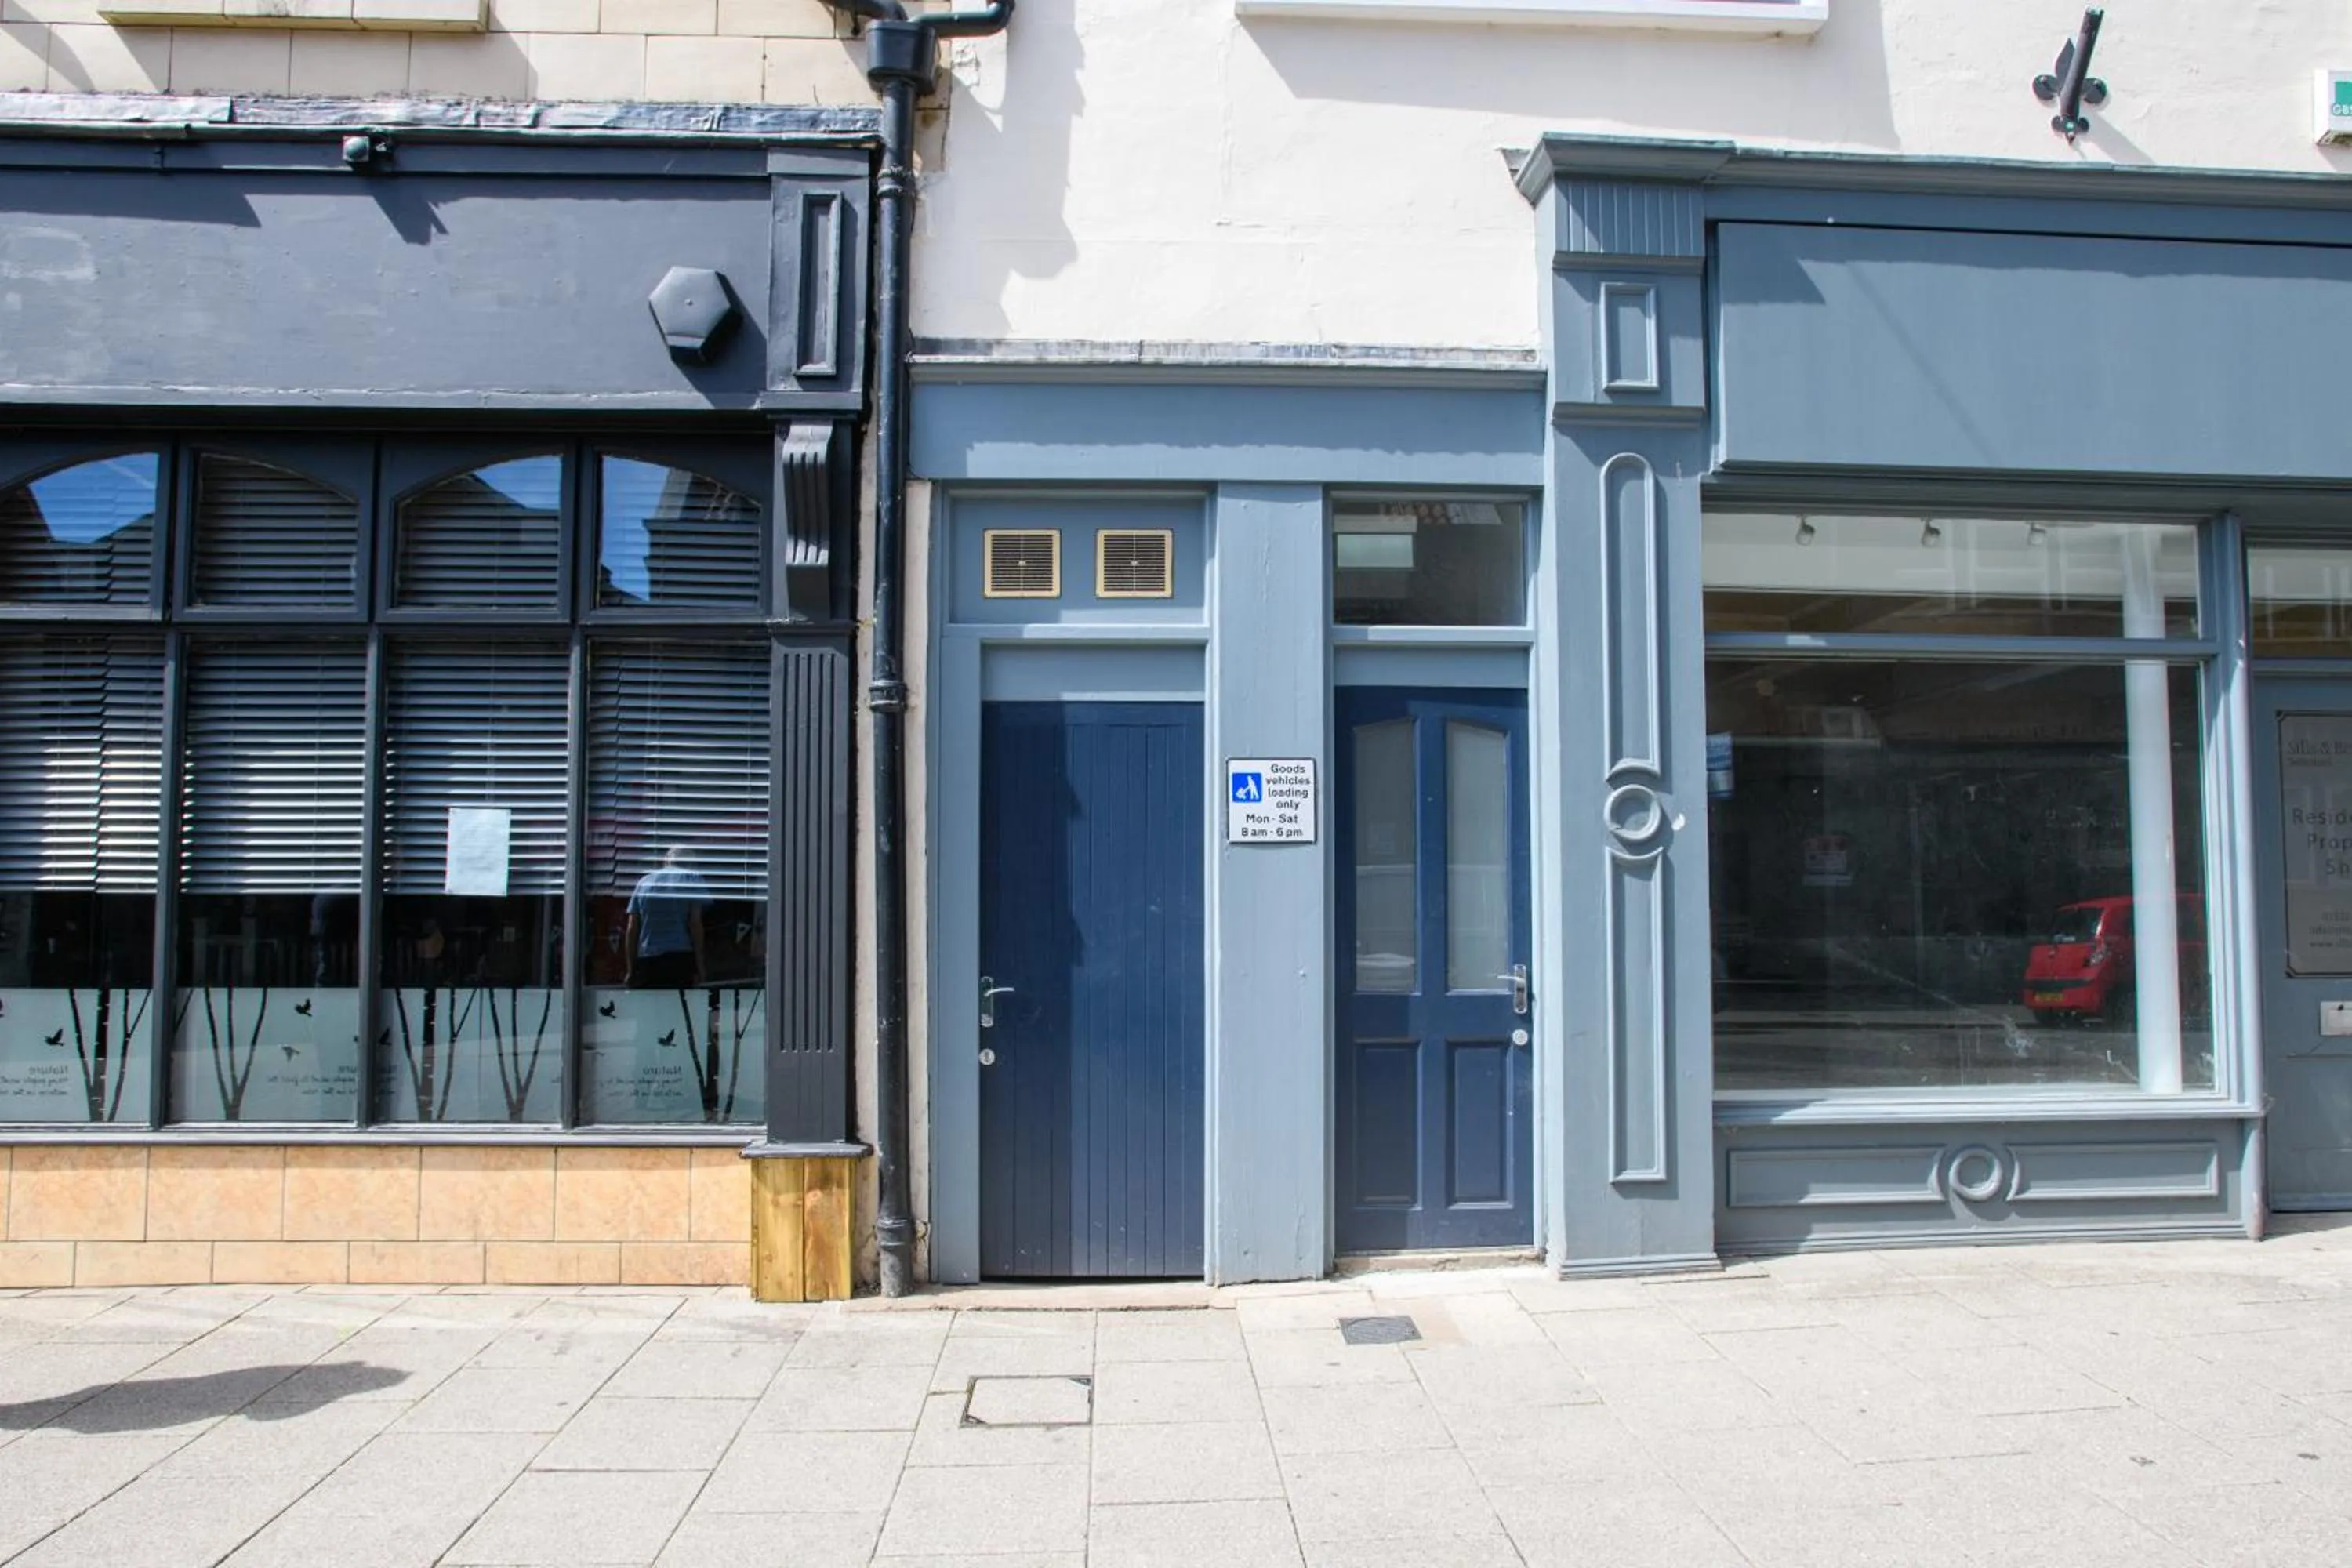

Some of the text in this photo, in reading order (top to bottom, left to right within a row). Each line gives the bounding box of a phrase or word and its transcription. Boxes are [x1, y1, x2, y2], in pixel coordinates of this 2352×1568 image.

[1270, 764, 1305, 774] Goods
[1266, 775, 1311, 785] vehicles
[1268, 787, 1308, 798] loading
[1276, 800, 1300, 811] only
[1246, 814, 1270, 823] Mon
[1279, 814, 1299, 823] Sat
[2292, 808, 2352, 826] Resid
